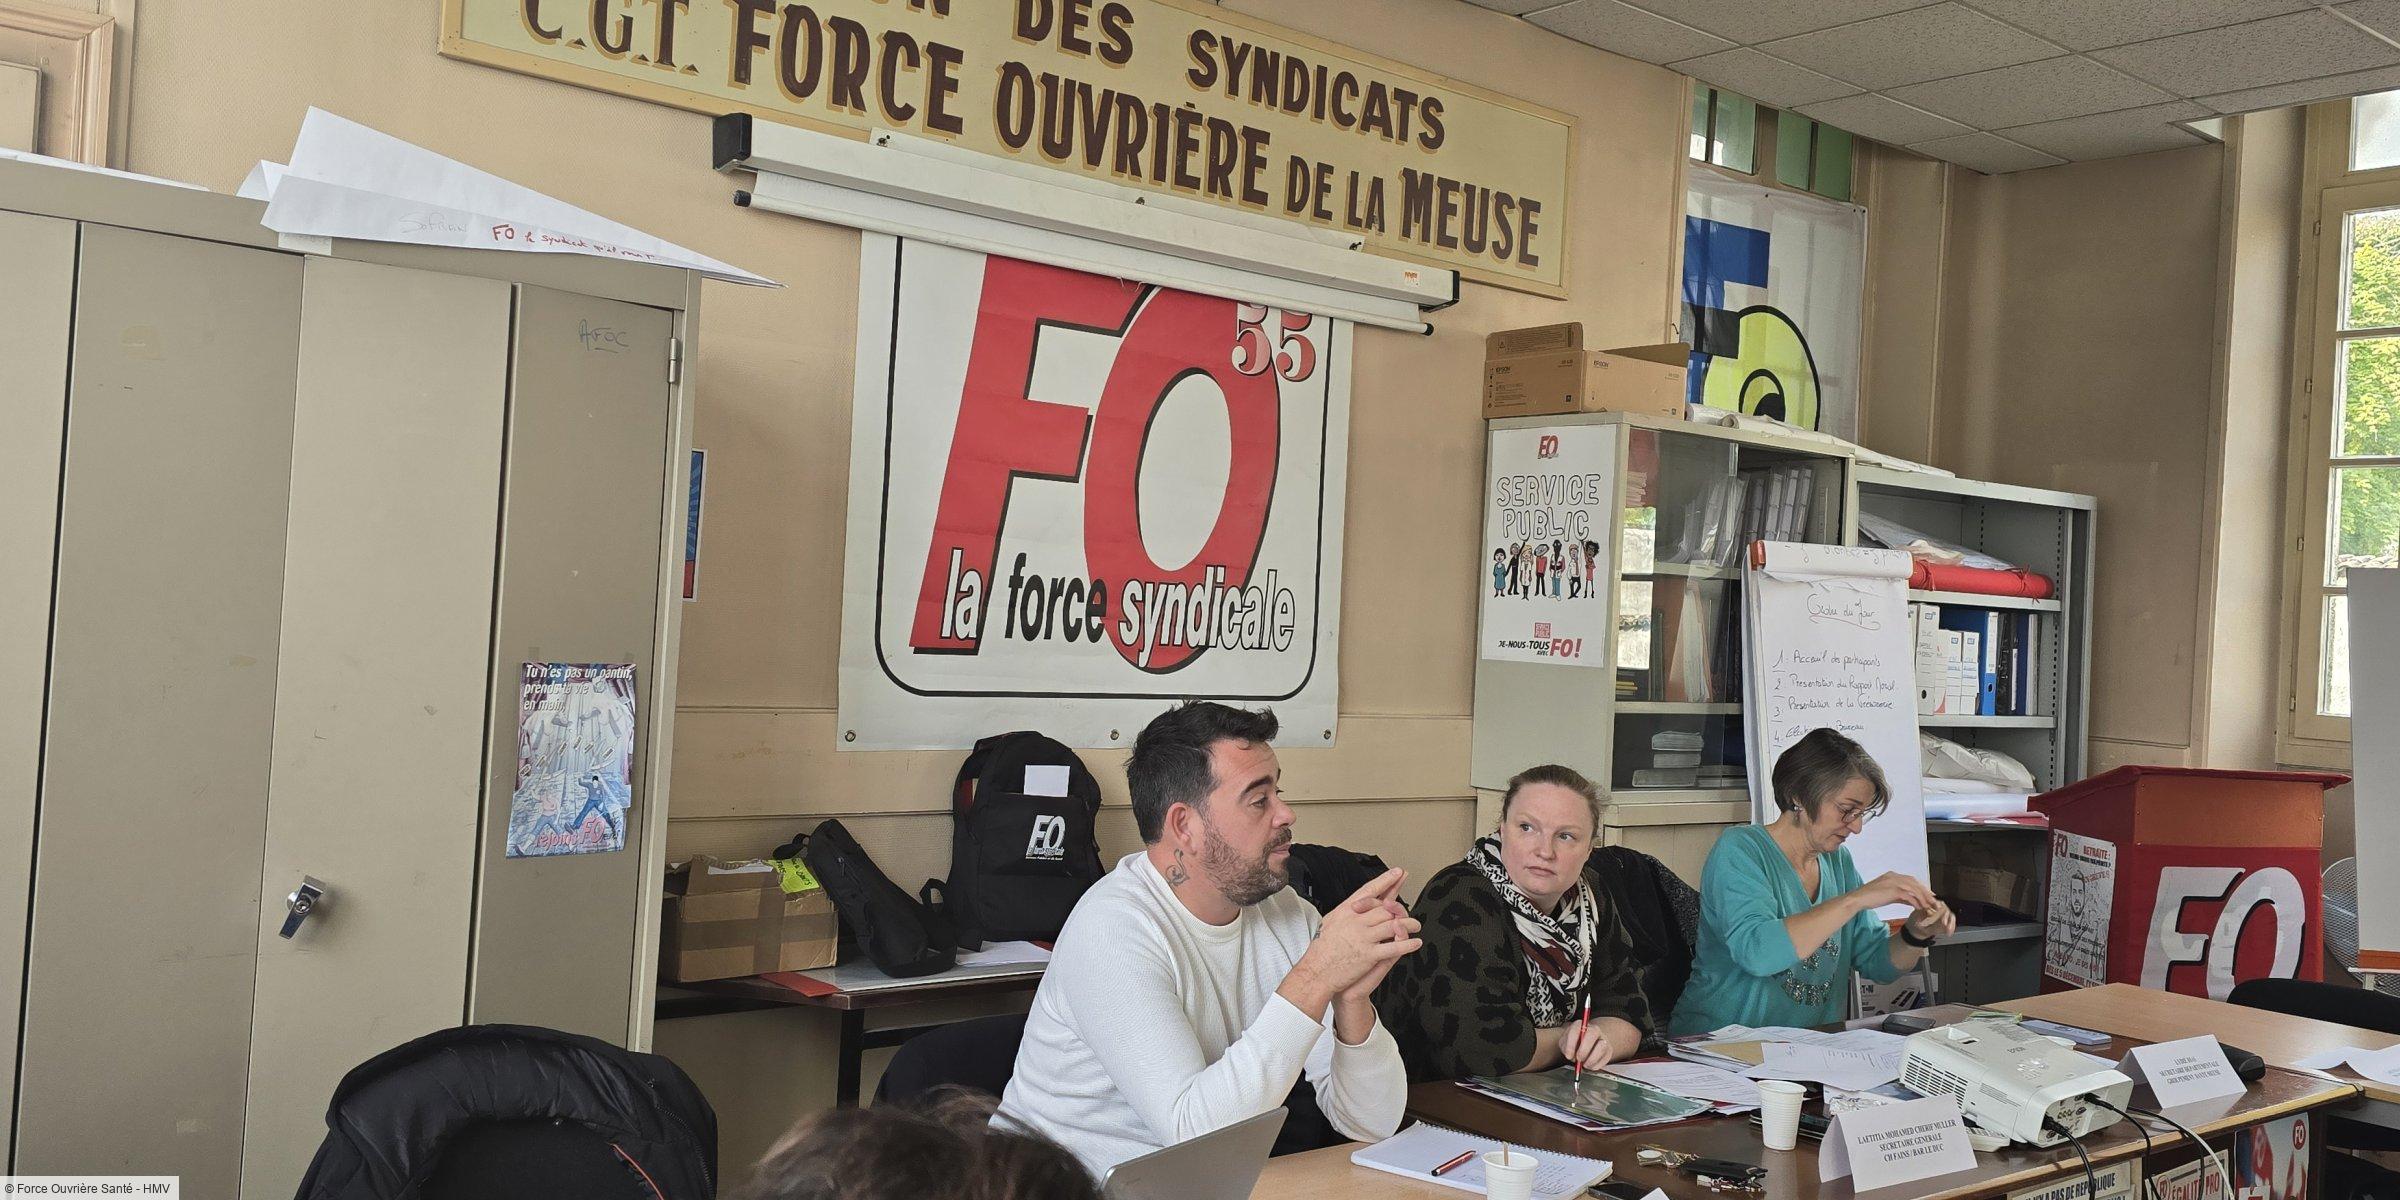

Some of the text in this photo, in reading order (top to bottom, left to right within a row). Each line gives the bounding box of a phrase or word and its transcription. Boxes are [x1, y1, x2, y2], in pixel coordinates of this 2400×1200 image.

[1014, 0, 1445, 153] DES SYNDICATS
[732, 0, 964, 137] FORCE
[995, 61, 1270, 206] OUVRIÈRE
[1285, 155, 1334, 222] DE
[1346, 171, 1385, 235] LA
[1398, 167, 1541, 268] MEUSE
[492, 224, 515, 241] FO
[1231, 302, 1317, 383] 55
[1538, 435, 1559, 458] FO
[909, 253, 1281, 674] FO
[1497, 474, 1601, 507] SERVICE
[1503, 507, 1589, 542] PUBLIC
[939, 547, 1295, 668] la force syndicale
[526, 665, 538, 678] Tu
[540, 665, 562, 678] n'es
[564, 667, 582, 681] pas
[584, 667, 597, 679] un
[524, 700, 536, 711] en
[580, 817, 606, 845] FO
[1026, 815, 1066, 857] FO
[2055, 832, 2069, 857] FO
[2140, 866, 2306, 1002] FO
[1857, 1119, 1957, 1145] LAETITIA MOHAMED CHERIF MULLER
[1879, 1132, 1942, 1152] SECRETAIRE GENERALE
[1893, 1150, 1910, 1161] FAINS
[1913, 1146, 1925, 1156] BAR
[1924, 1145, 1933, 1154] LE
[2065, 1184, 2075, 1200] DE
